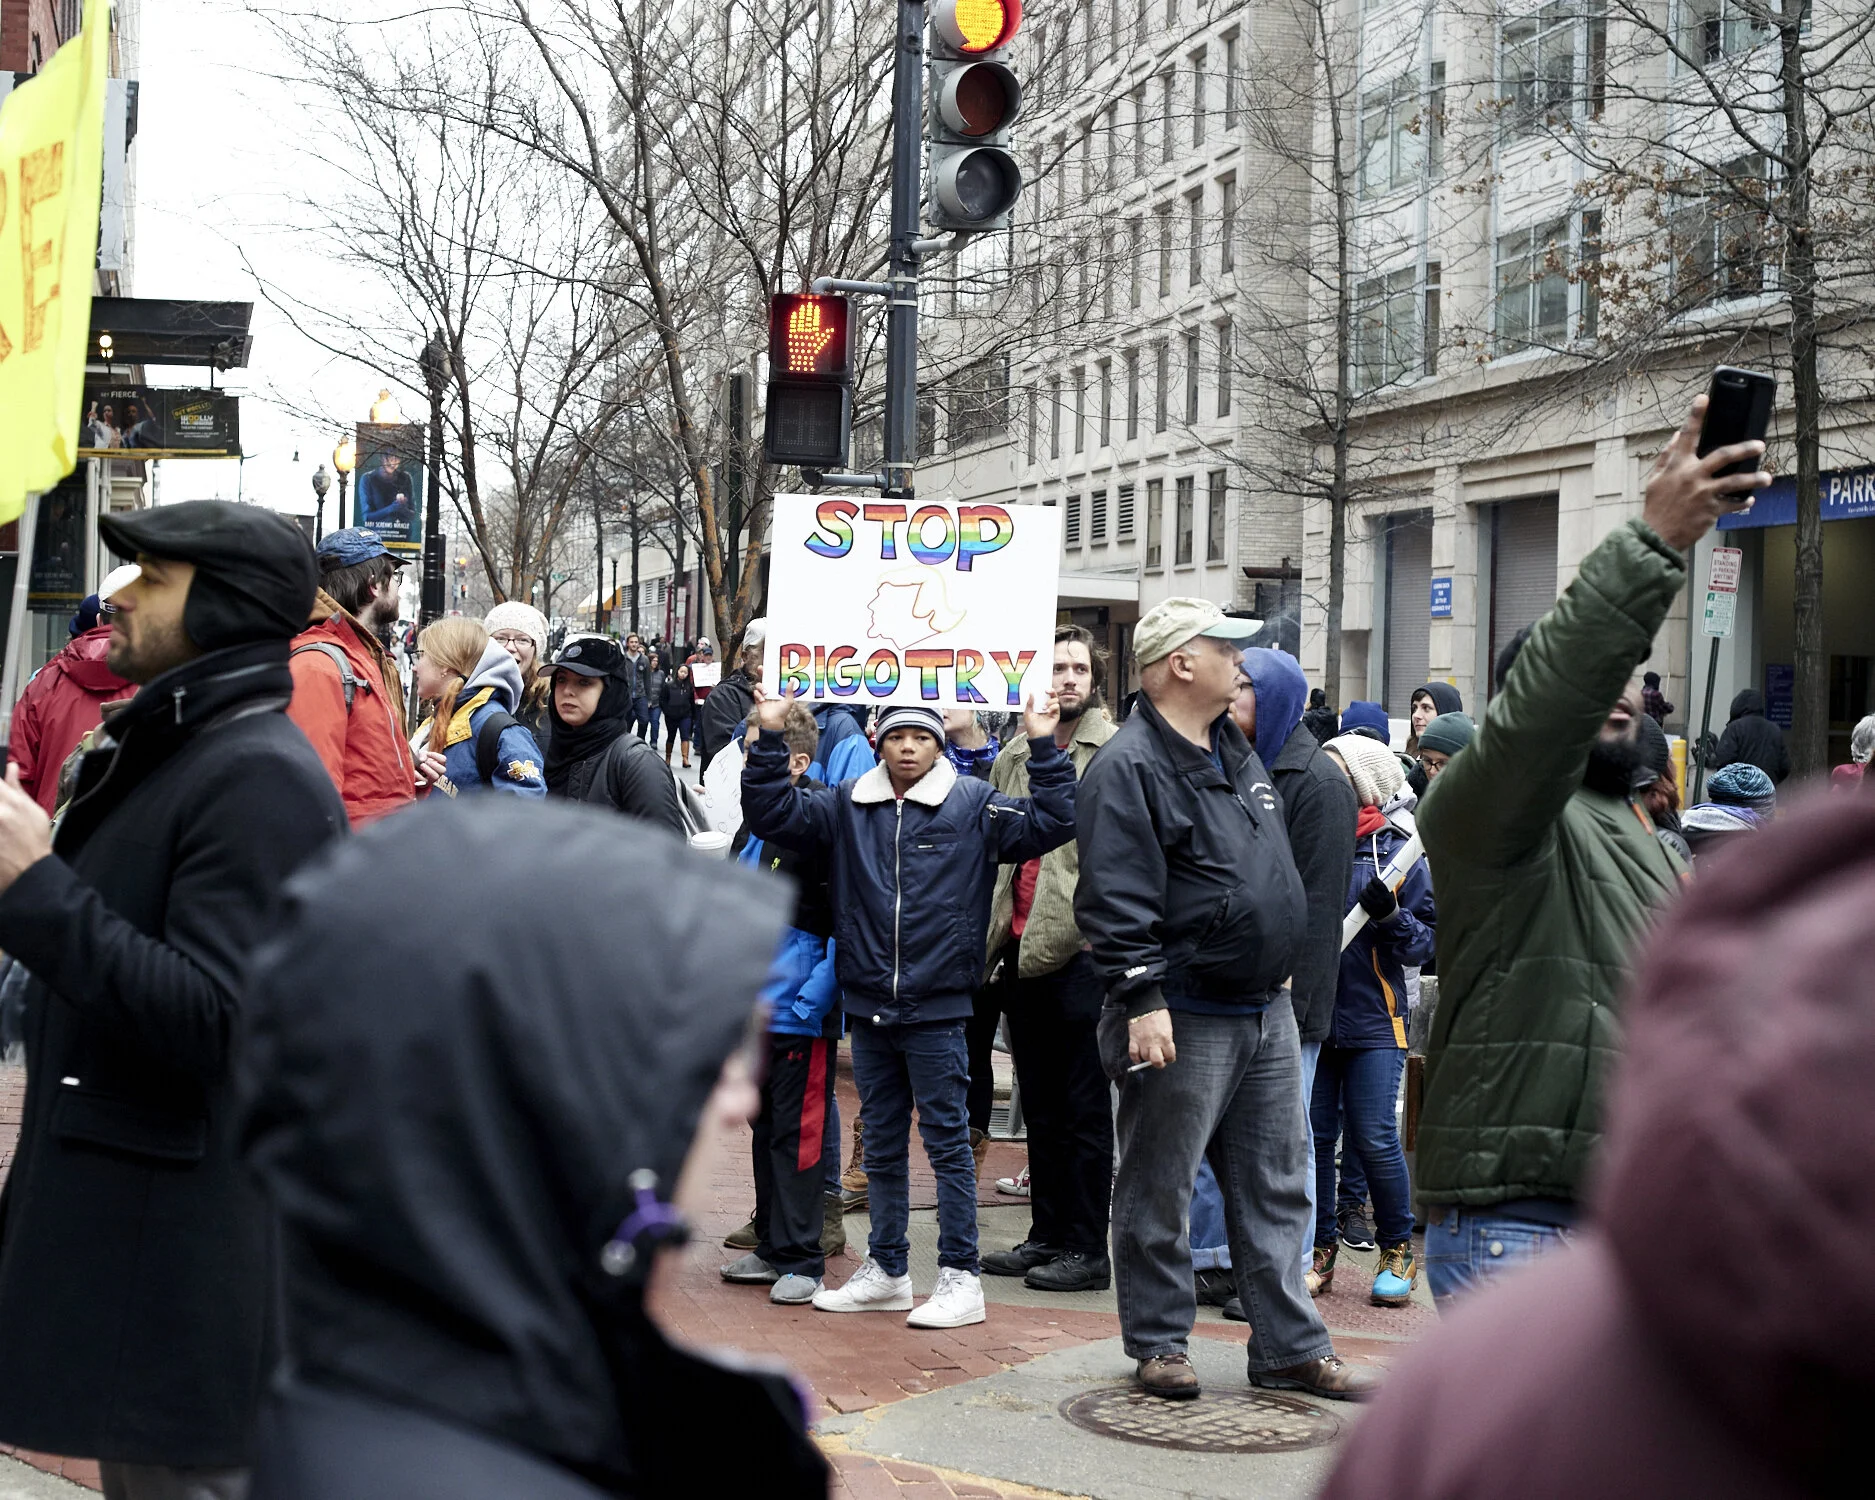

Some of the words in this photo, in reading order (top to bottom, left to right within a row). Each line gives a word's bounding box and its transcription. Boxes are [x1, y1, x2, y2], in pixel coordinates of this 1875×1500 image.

[111, 391, 139, 399] FIERCE.
[1830, 474, 1875, 505] PARK
[803, 499, 1014, 572] STOP
[777, 642, 1038, 707] BIGOTRY
